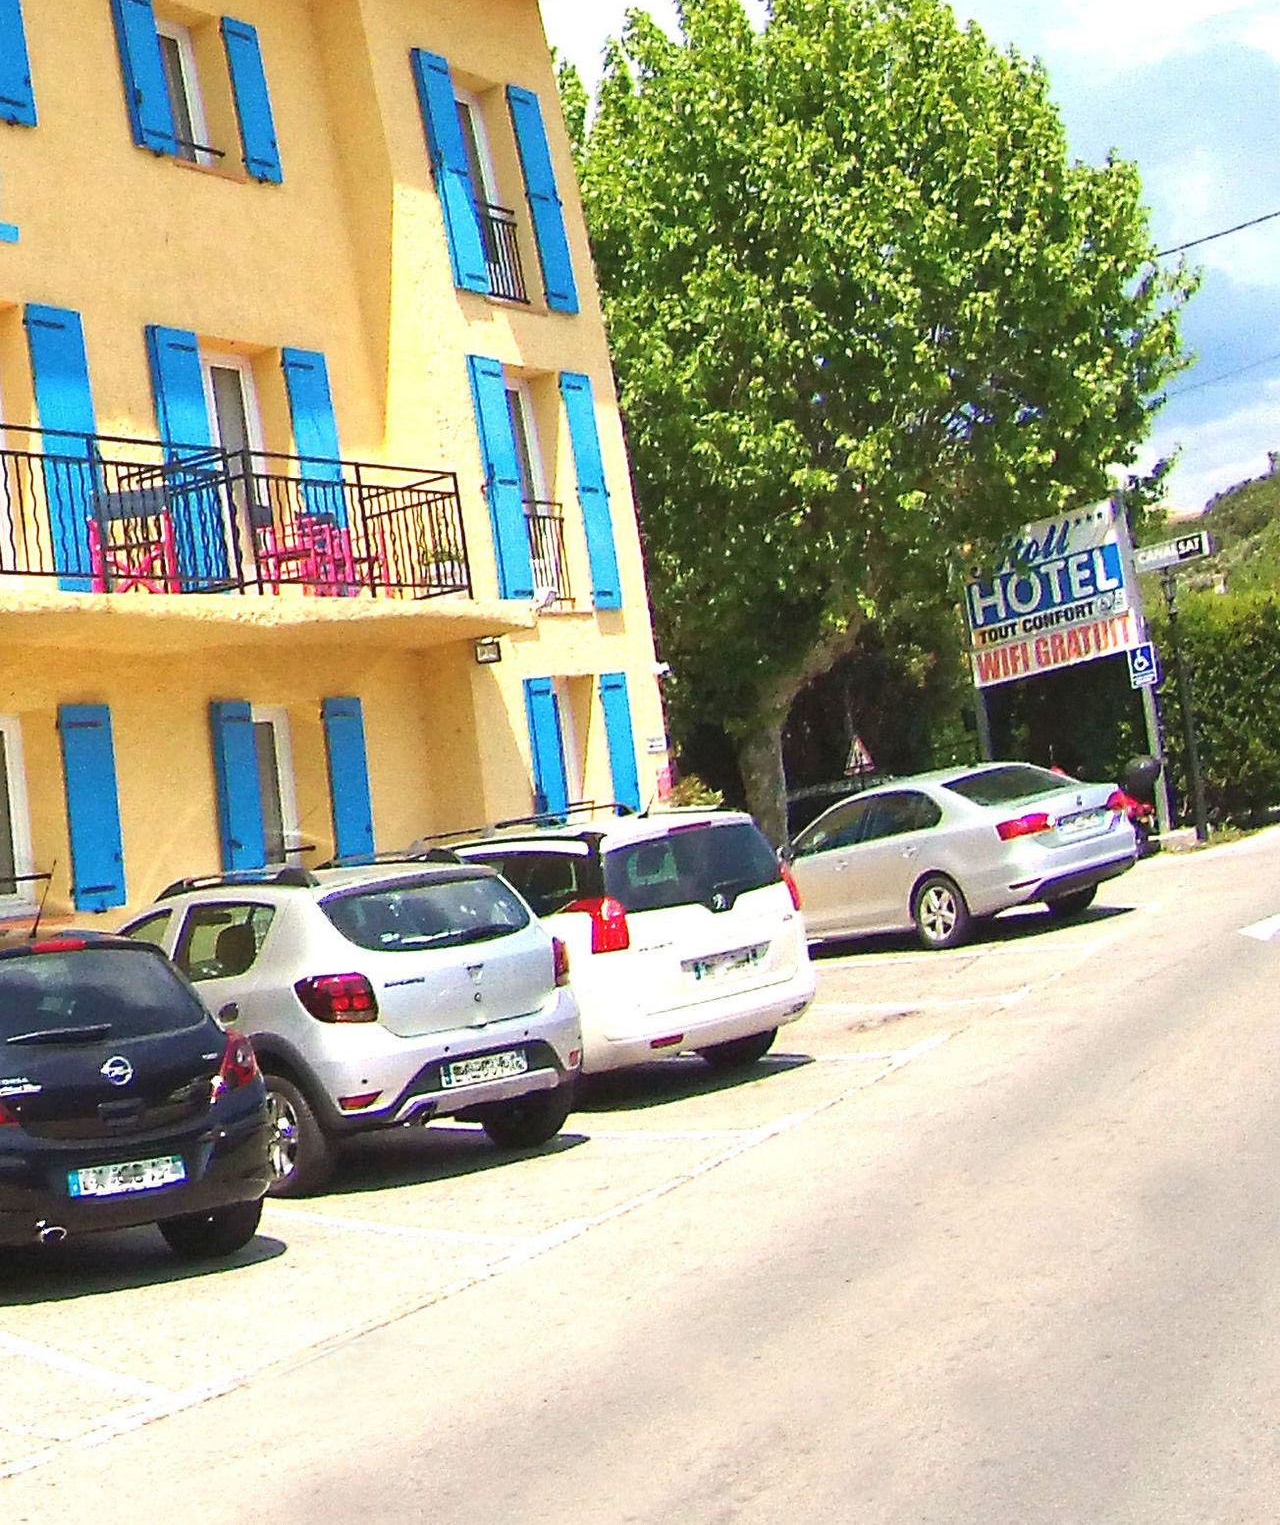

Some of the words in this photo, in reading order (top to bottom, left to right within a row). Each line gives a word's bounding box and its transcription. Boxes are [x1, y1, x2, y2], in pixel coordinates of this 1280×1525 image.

[970, 548, 1120, 626] HOTEL
[975, 641, 1031, 683] WIFI
[1034, 615, 1132, 669] GRATUIT
[980, 624, 1018, 645] TOUT
[1022, 601, 1095, 633] CONFORT
